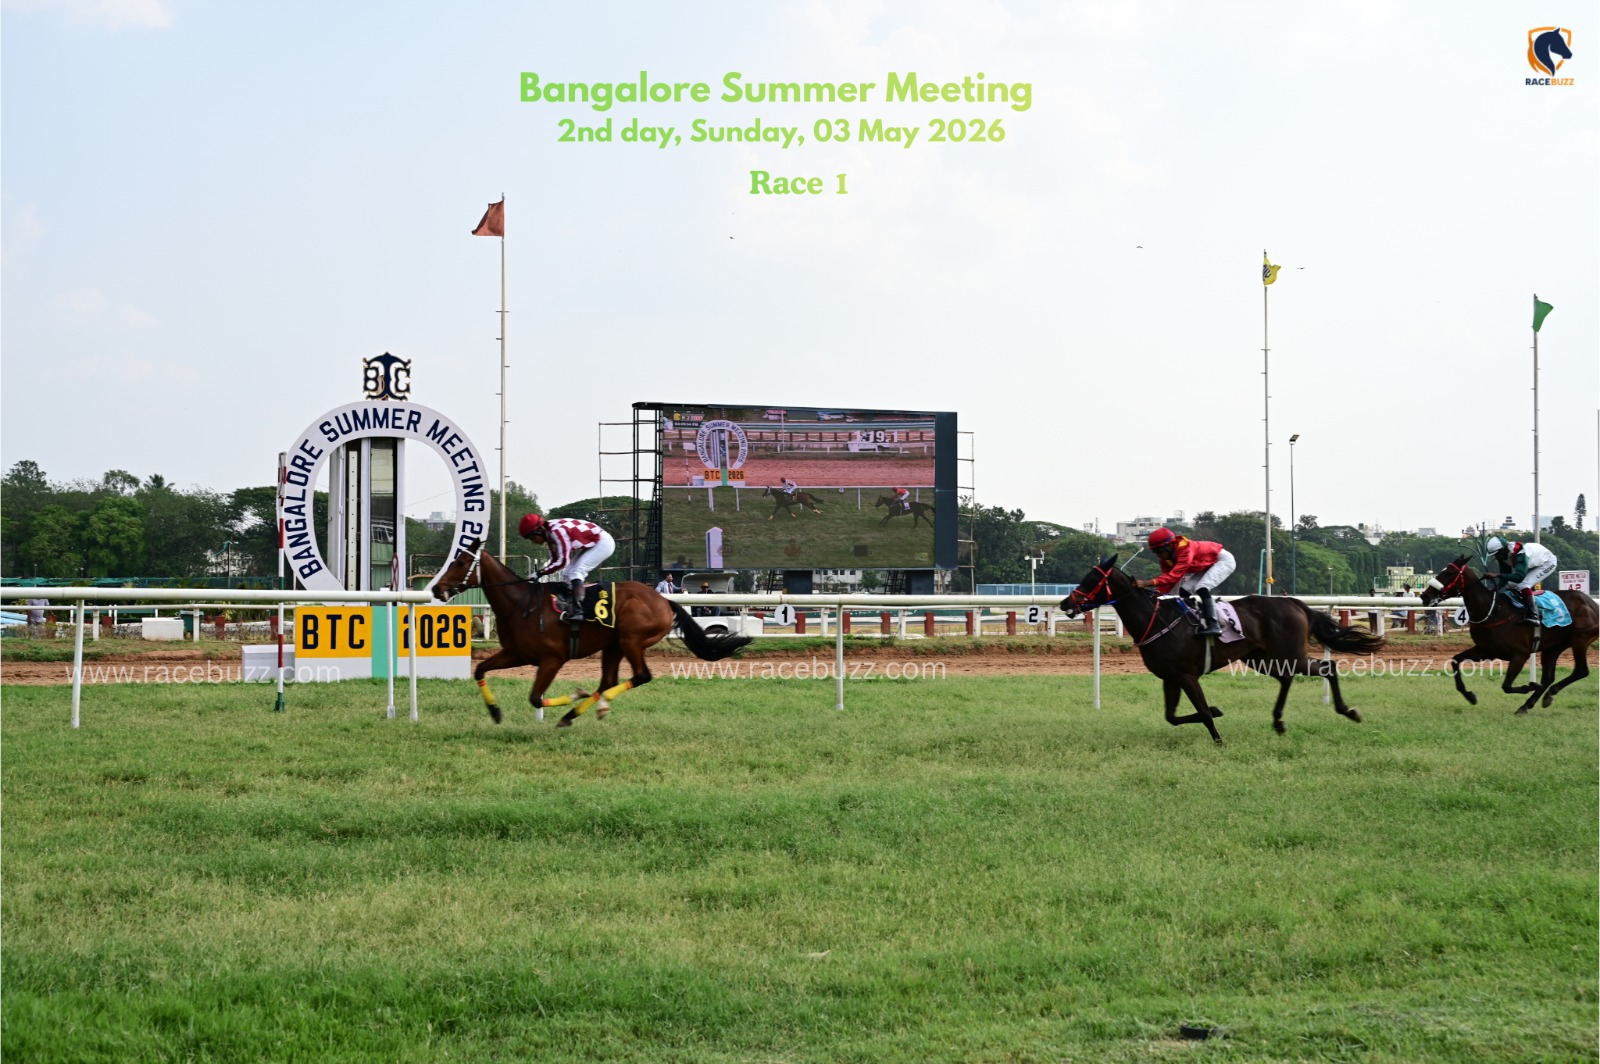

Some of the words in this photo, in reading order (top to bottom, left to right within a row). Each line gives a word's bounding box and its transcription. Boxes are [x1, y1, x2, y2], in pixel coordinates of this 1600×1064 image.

[319, 407, 422, 443] SUMMER
[705, 421, 730, 431] SUMMER
[426, 419, 486, 512] MEETING
[704, 470, 720, 480] BTC
[728, 470, 744, 480] 2026
[284, 439, 324, 580] BANGALORE
[453, 520, 484, 560] 20
[594, 599, 609, 619] 6
[781, 606, 788, 623] 1
[1028, 607, 1039, 623] 2
[1457, 609, 1467, 624] 4
[1553, 607, 1566, 623] 3
[302, 613, 365, 650] BTC
[403, 613, 467, 649] 2026
